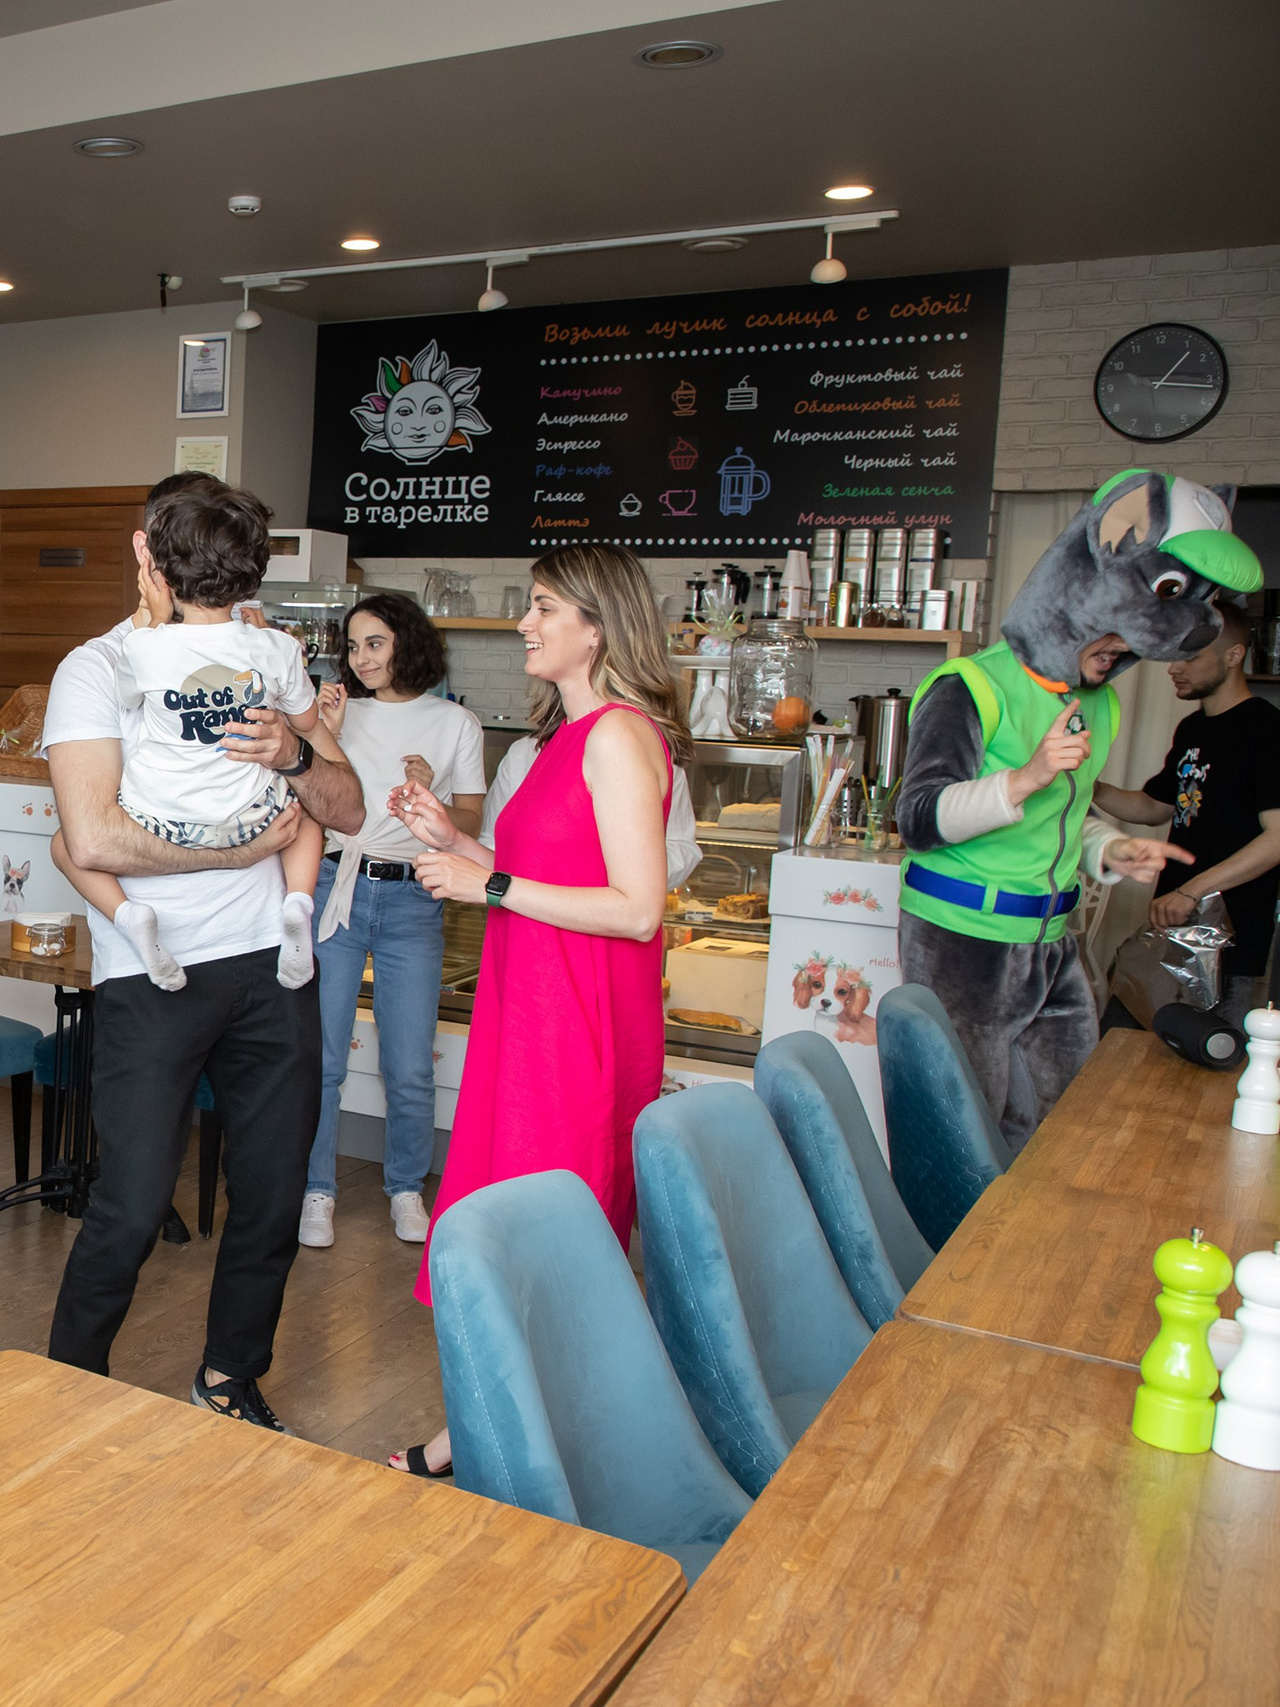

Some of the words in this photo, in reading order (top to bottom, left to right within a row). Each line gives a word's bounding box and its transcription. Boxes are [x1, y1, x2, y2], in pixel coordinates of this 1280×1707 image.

[544, 323, 630, 346] Возьми
[646, 317, 727, 339] лучик
[745, 308, 838, 328] солнца
[856, 307, 870, 321] с
[889, 293, 971, 318] собой!
[1155, 335, 1166, 344] 12
[1184, 340, 1190, 348] 1
[1131, 345, 1141, 353] 11
[1200, 354, 1206, 362] 2
[1114, 362, 1124, 370] 10
[809, 366, 919, 388] Фруктовый
[927, 363, 964, 380] чай
[1206, 375, 1213, 383] 3
[540, 386, 622, 401] Капучино
[1107, 384, 1114, 393] 9
[794, 395, 918, 415] Облепиховый
[925, 393, 961, 409] чай
[1113, 404, 1120, 412] 8
[537, 412, 629, 427] Американо
[1131, 419, 1137, 427] 7
[1181, 415, 1187, 423] 5
[773, 424, 916, 446] Марокканский
[923, 422, 960, 439] чай
[1154, 423, 1161, 432] 6
[536, 438, 601, 454] Эспрессо
[844, 453, 913, 472] Черный
[920, 452, 957, 468] чай
[535, 462, 613, 479] Раф-кофе
[344, 472, 491, 504] Солнце
[822, 483, 895, 498] Зеленая
[901, 484, 955, 497] сенча
[534, 490, 586, 503] Гляссе
[344, 507, 360, 524] в
[365, 504, 489, 529] тарелке
[531, 515, 590, 529] Латтэ
[797, 510, 898, 526] Молочный
[904, 512, 953, 528] улун
[164, 688, 210, 710] Out
[211, 686, 234, 707] of
